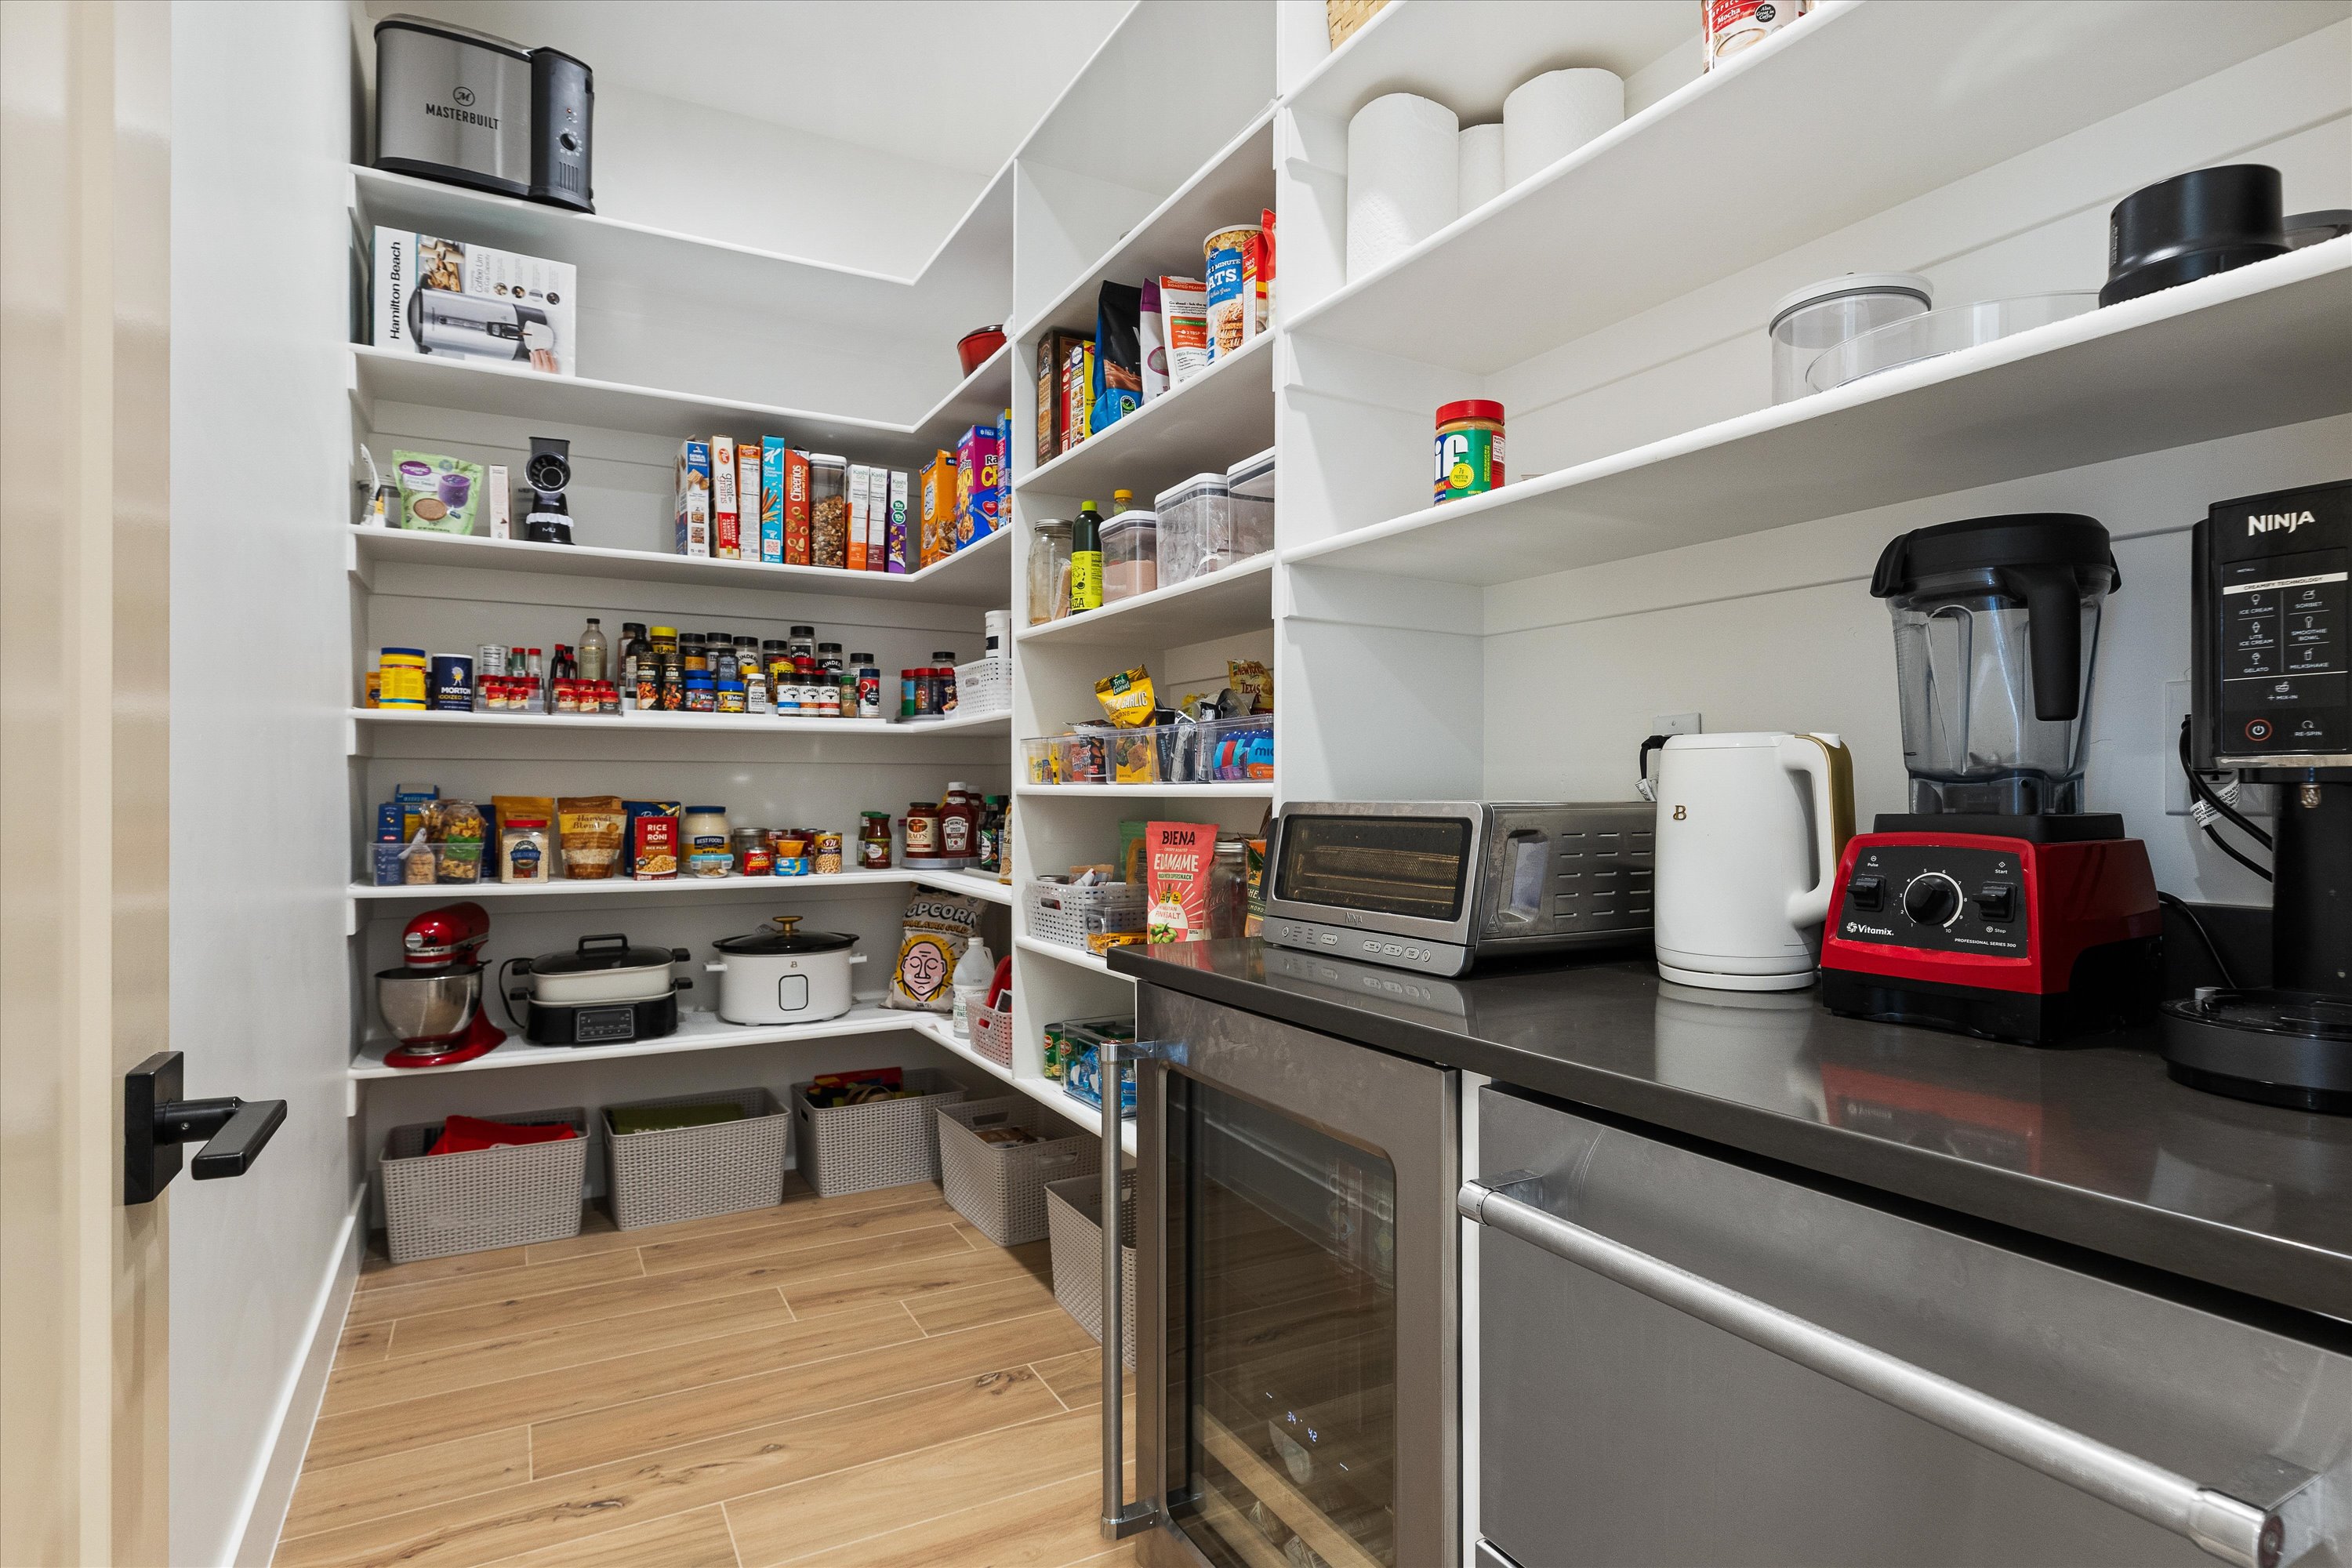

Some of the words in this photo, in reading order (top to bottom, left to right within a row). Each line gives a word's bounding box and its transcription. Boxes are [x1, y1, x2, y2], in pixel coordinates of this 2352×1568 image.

[1717, 8, 1740, 24] Mocha
[426, 103, 499, 130] MASTERBUILT
[390, 241, 401, 281] Beach
[1215, 259, 1241, 270] MINUTE
[390, 283, 401, 339] Hamilton
[717, 475, 727, 504] grains
[725, 474, 735, 495] great
[790, 465, 802, 502] Cheerios
[2248, 510, 2316, 536] NINJA
[2277, 577, 2323, 586] TECHNOLOGY
[1114, 677, 1126, 688] Fresh
[1240, 682, 1261, 695] TEXAS
[1121, 691, 1148, 709] GARLIC
[1673, 805, 1686, 820] B
[1162, 831, 1195, 845] BIENA
[1154, 853, 1199, 872] EDAMAME
[1345, 912, 1363, 925] NINJA
[1287, 1411, 1297, 1425] 34
[1308, 1428, 1317, 1443] 42
